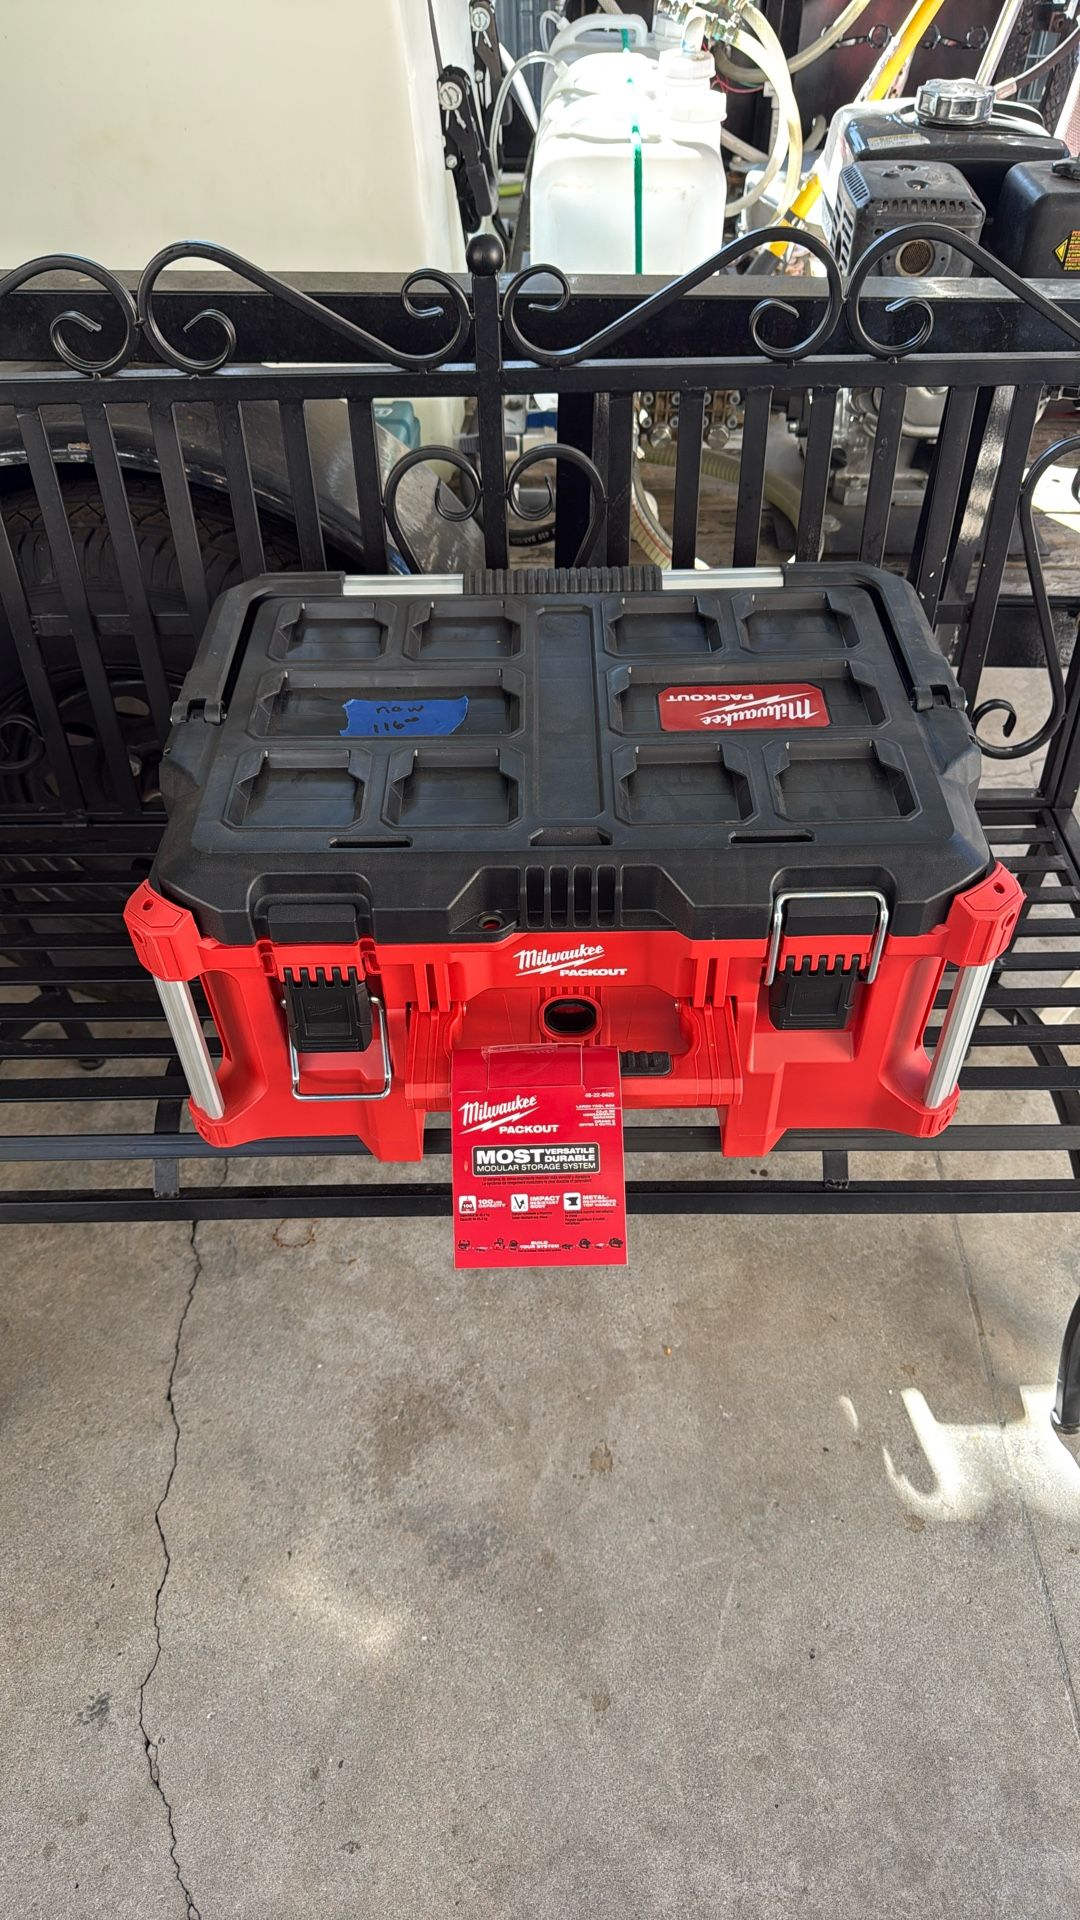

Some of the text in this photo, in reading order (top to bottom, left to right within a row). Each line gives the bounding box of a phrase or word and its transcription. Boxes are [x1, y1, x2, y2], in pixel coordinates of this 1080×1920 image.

[666, 694, 754, 702] PACKOUT
[700, 699, 820, 726] Milwaukee
[513, 944, 605, 970] Milwaukee
[458, 1095, 538, 1126] Milwaukee
[499, 1125, 559, 1134] PACKOUT
[544, 1147, 595, 1155] VERSATILE
[476, 1149, 545, 1164] MOST
[544, 1154, 595, 1162] DURABLE
[476, 1162, 596, 1172] MODULAR STORAGE SYSTEM
